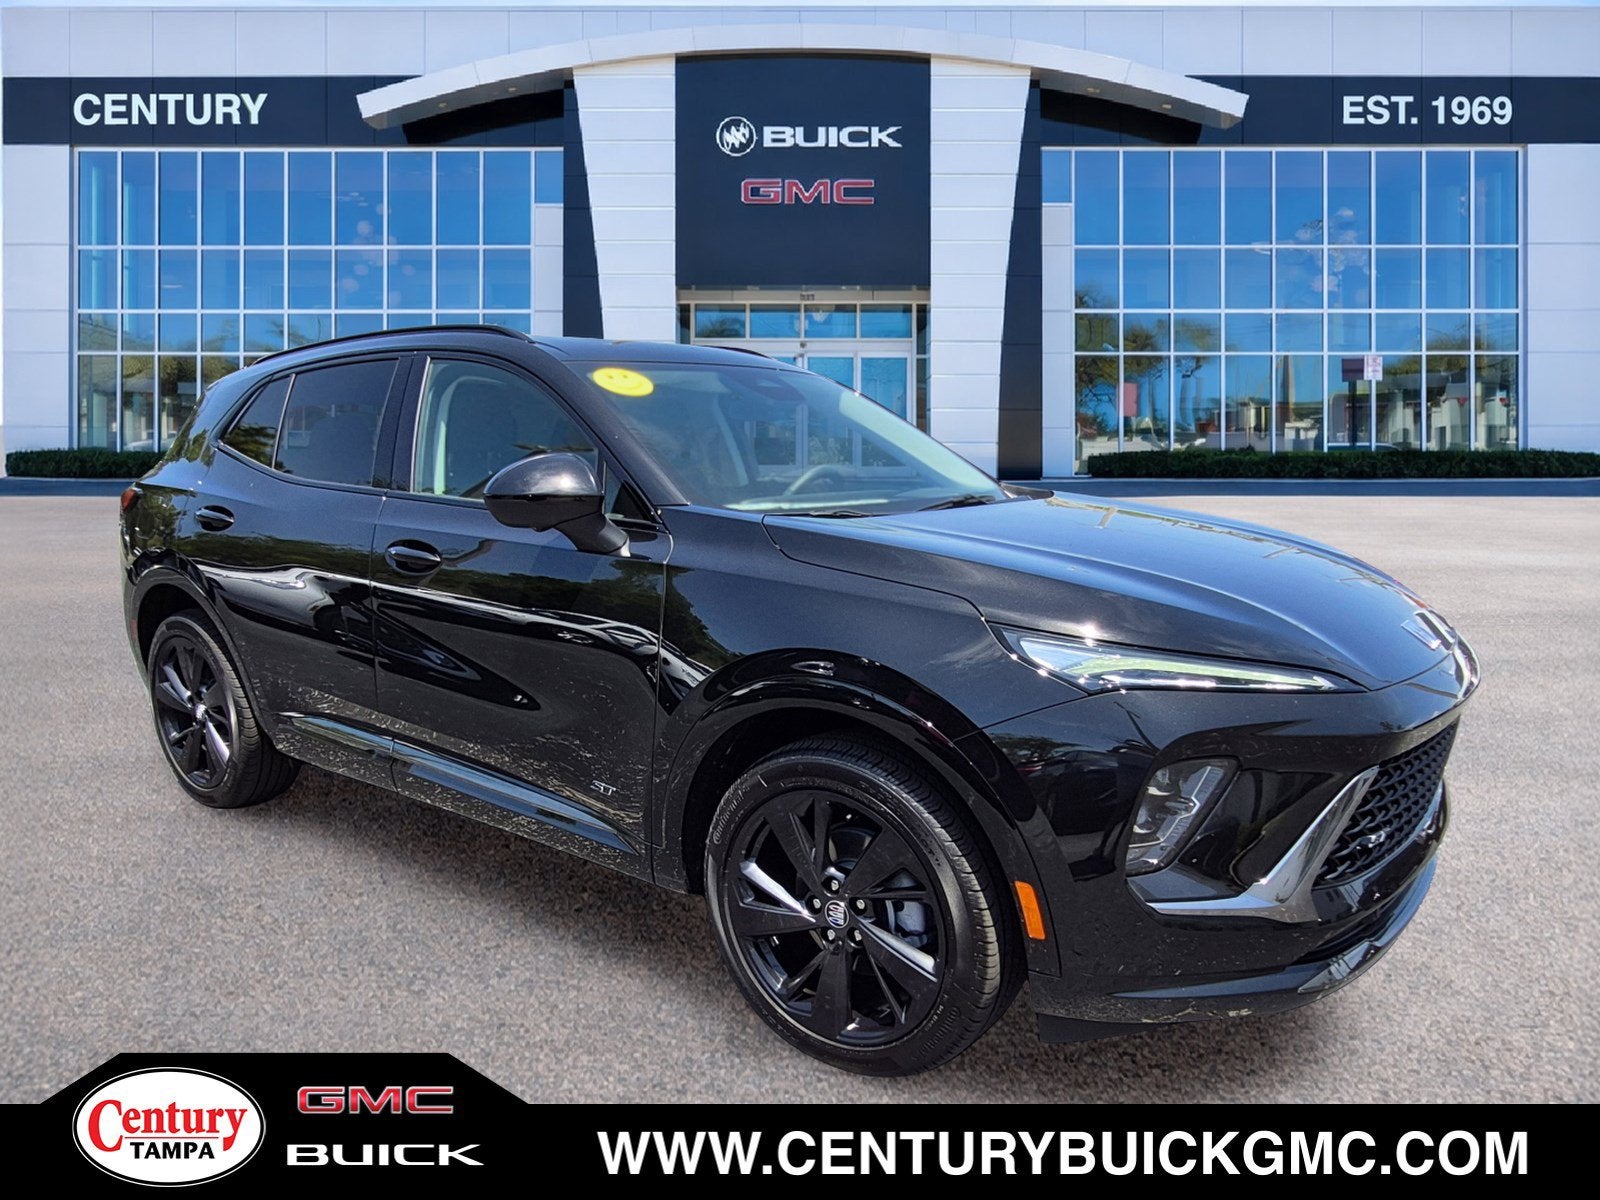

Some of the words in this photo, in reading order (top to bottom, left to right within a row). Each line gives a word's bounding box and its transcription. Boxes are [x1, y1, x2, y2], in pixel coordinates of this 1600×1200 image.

[73, 93, 268, 126] CENTURY
[1342, 95, 1418, 125] EST.
[1431, 95, 1513, 125] 1969
[763, 126, 902, 148] BUICK
[741, 178, 875, 205] GMC
